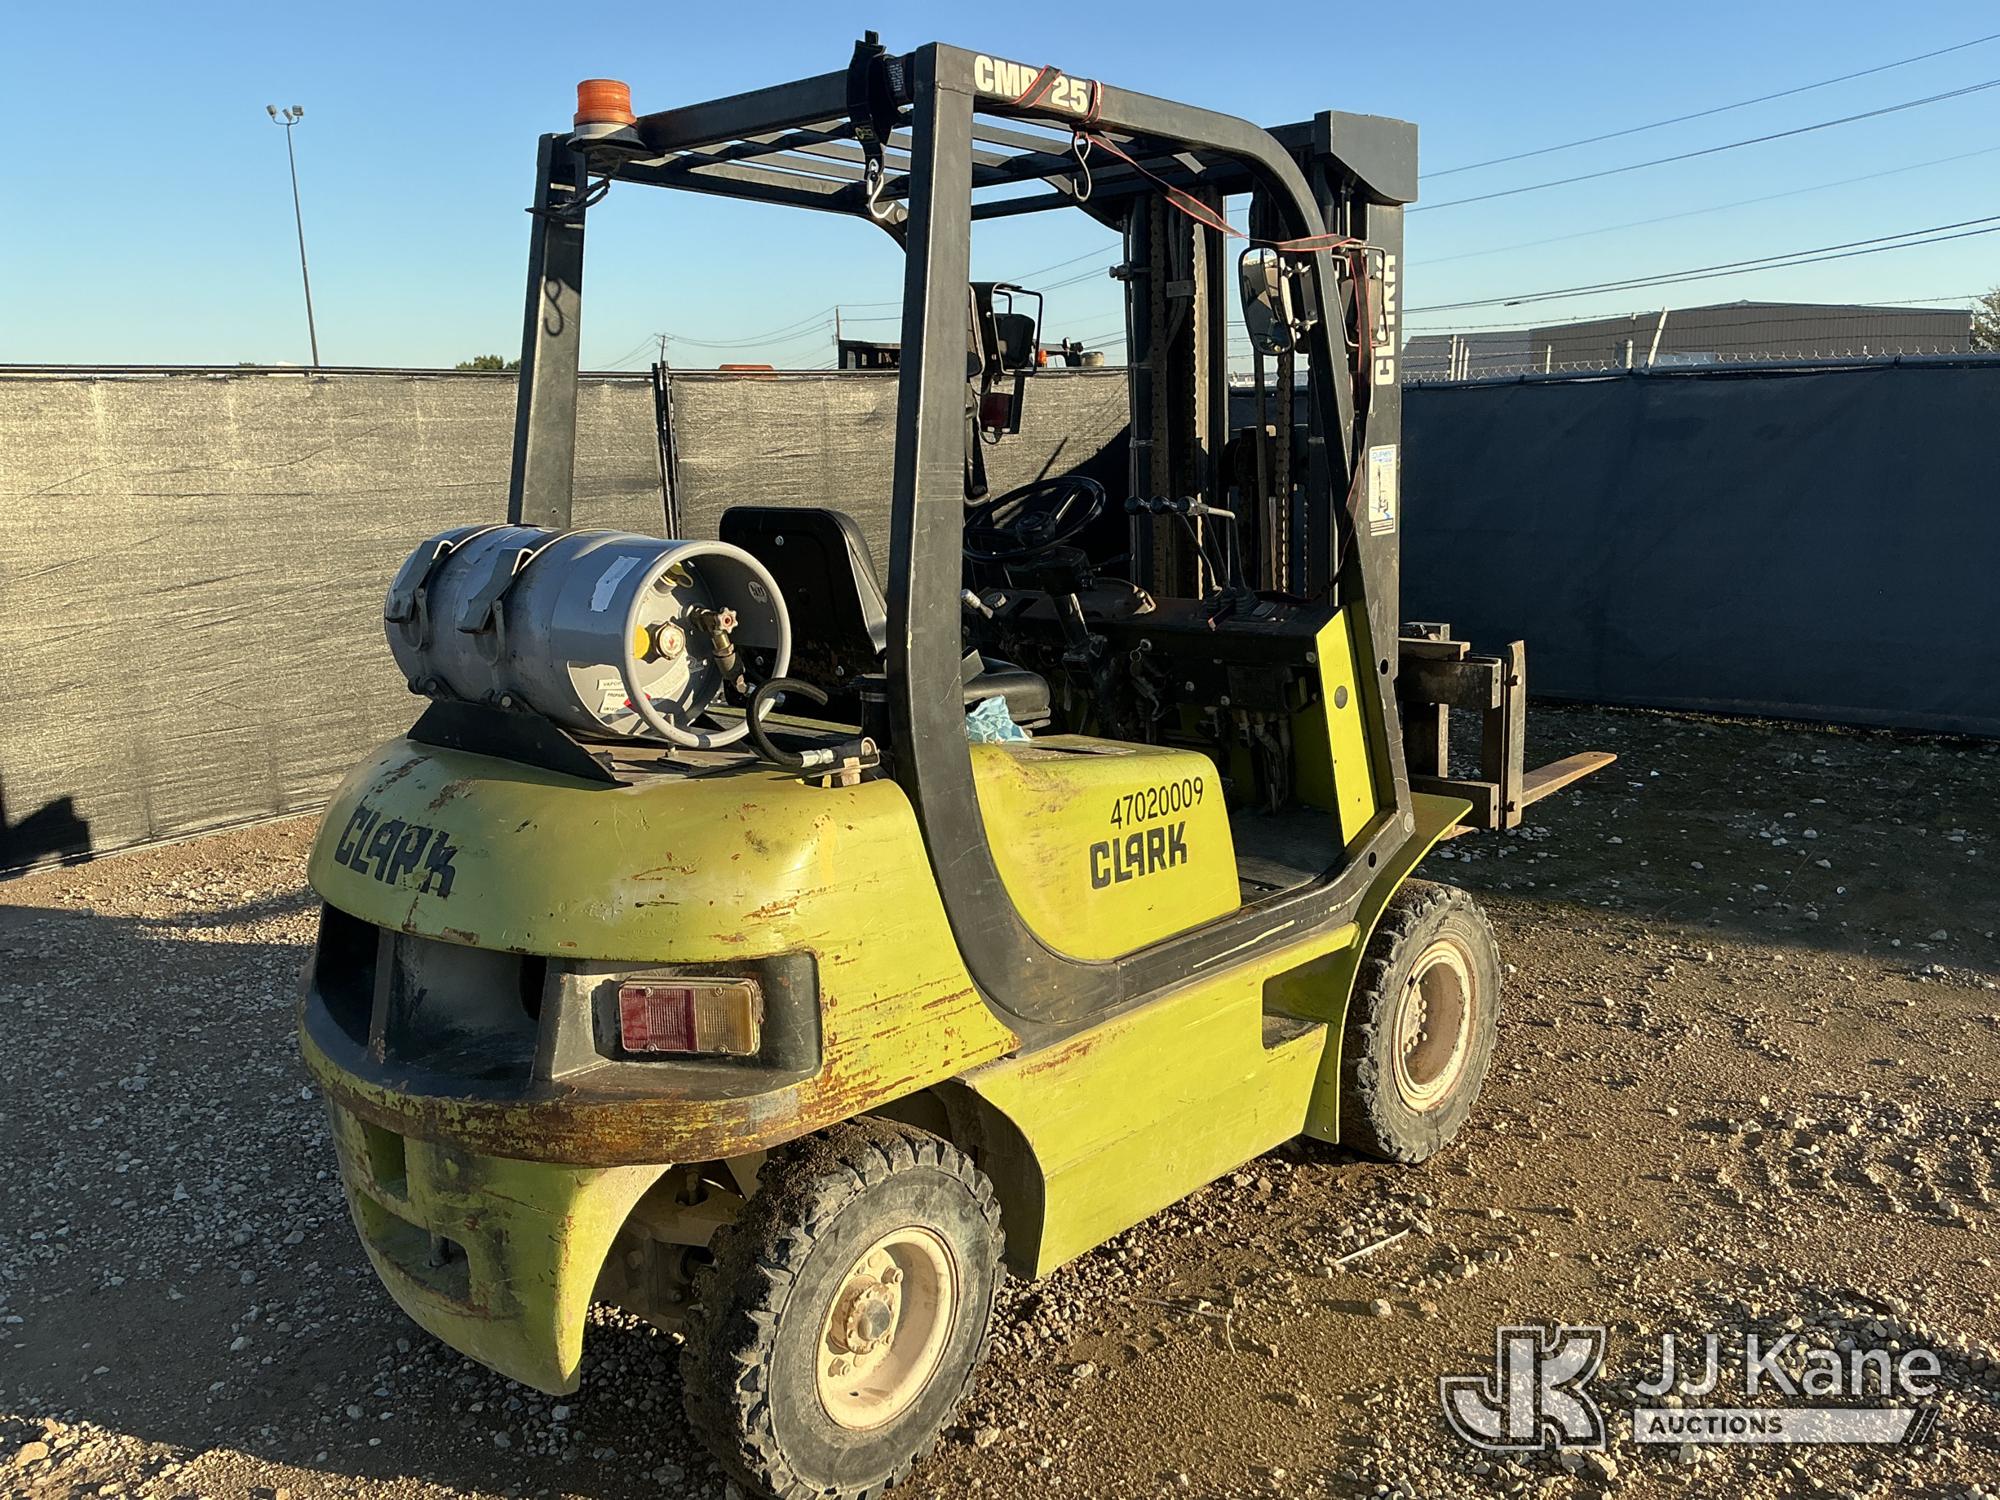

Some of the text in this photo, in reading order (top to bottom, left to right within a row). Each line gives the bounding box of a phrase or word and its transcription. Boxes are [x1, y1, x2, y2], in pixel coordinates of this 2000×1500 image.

[1051, 75, 1088, 113] 25
[1110, 776, 1204, 829] 47020009
[334, 805, 458, 900] CLARK
[1090, 821, 1187, 890] CLARK
